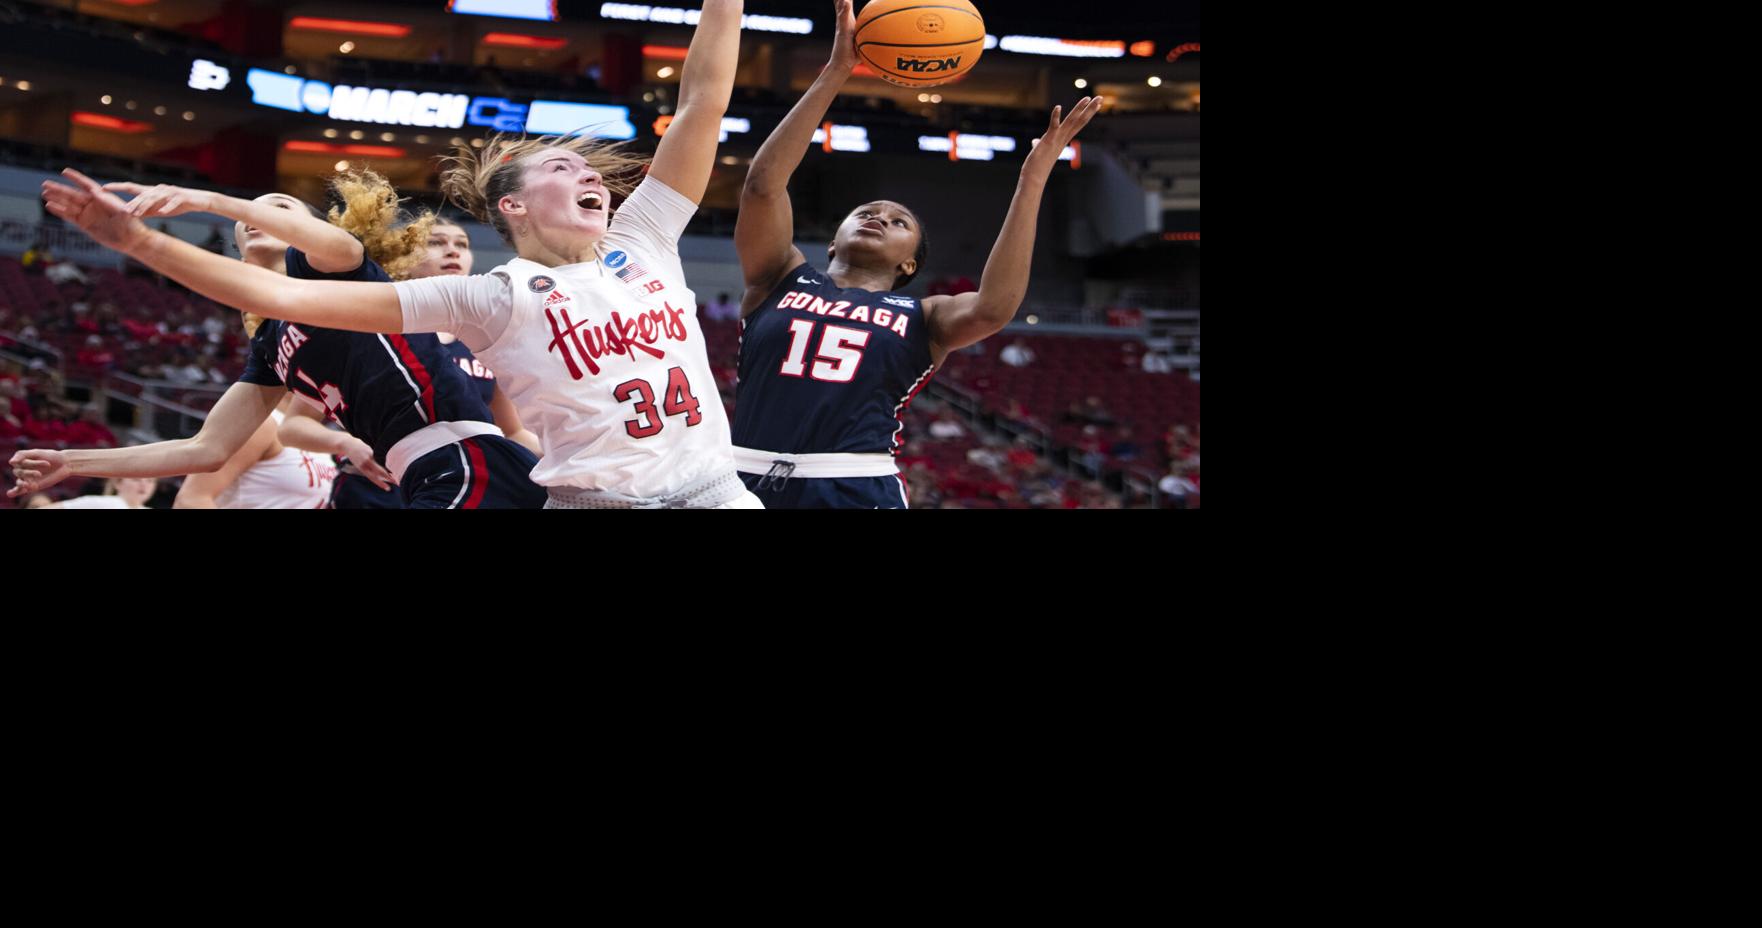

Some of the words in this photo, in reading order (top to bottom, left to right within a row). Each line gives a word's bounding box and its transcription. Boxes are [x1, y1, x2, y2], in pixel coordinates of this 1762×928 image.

[896, 55, 962, 72] NCAA
[328, 84, 470, 129] MARCH
[544, 301, 687, 381] Huskers
[776, 291, 909, 338] GONZAGA
[778, 318, 872, 384] 15
[612, 366, 702, 439] 34
